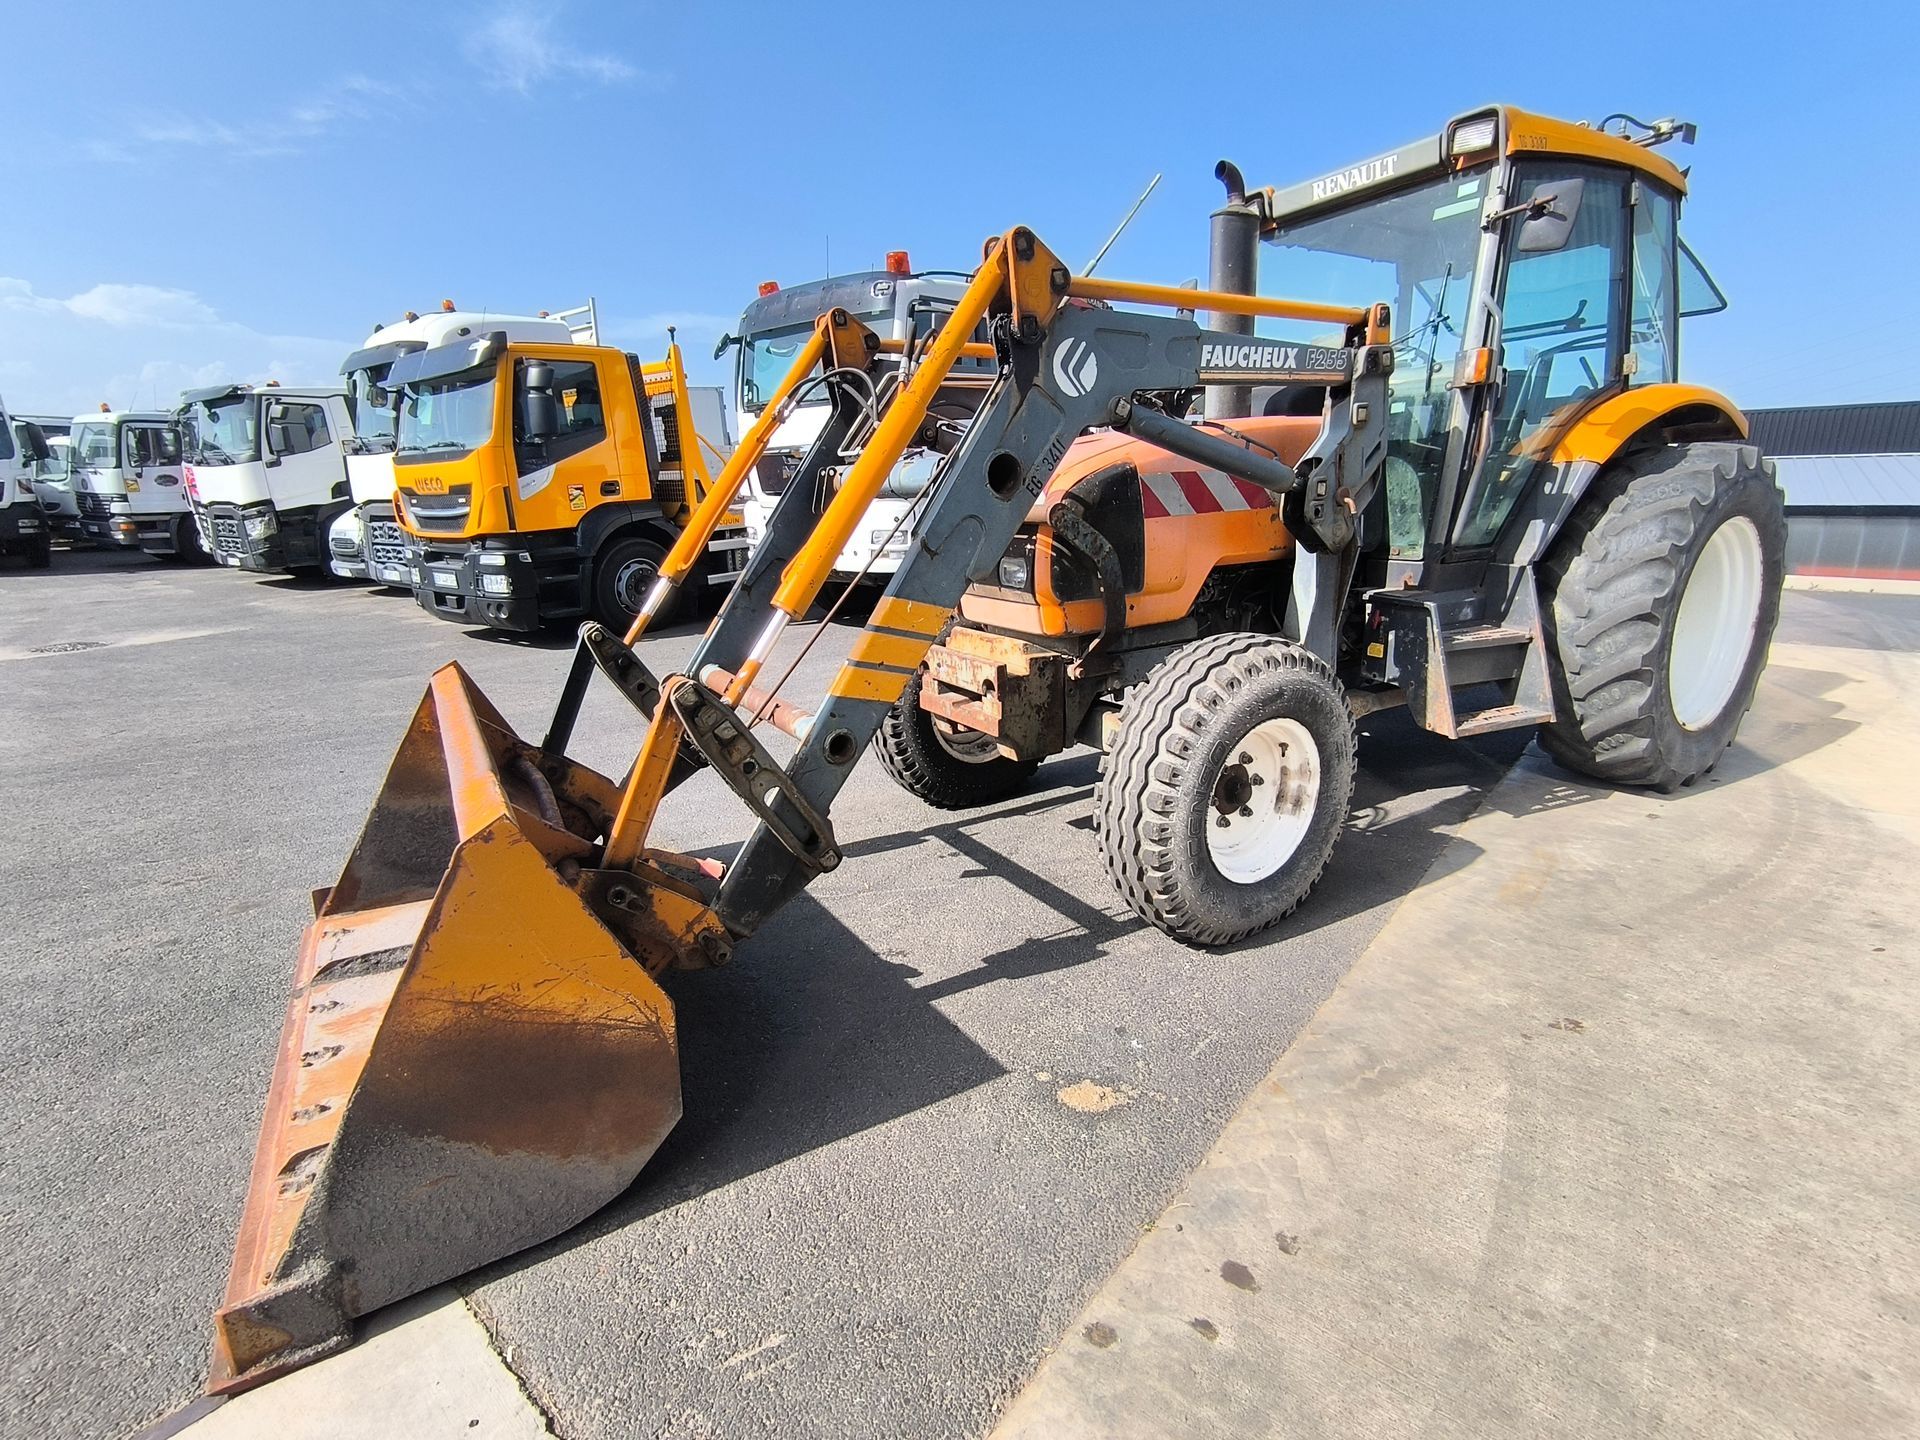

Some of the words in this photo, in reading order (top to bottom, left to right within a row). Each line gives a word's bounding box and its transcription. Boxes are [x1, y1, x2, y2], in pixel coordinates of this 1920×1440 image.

[1312, 154, 1398, 201] RENAULT
[1200, 344, 1299, 369] FAUCHEUX
[1306, 348, 1348, 370] F255
[1042, 438, 1066, 472] 3411
[415, 477, 445, 492] IVECO
[719, 518, 740, 526] CQUIN
